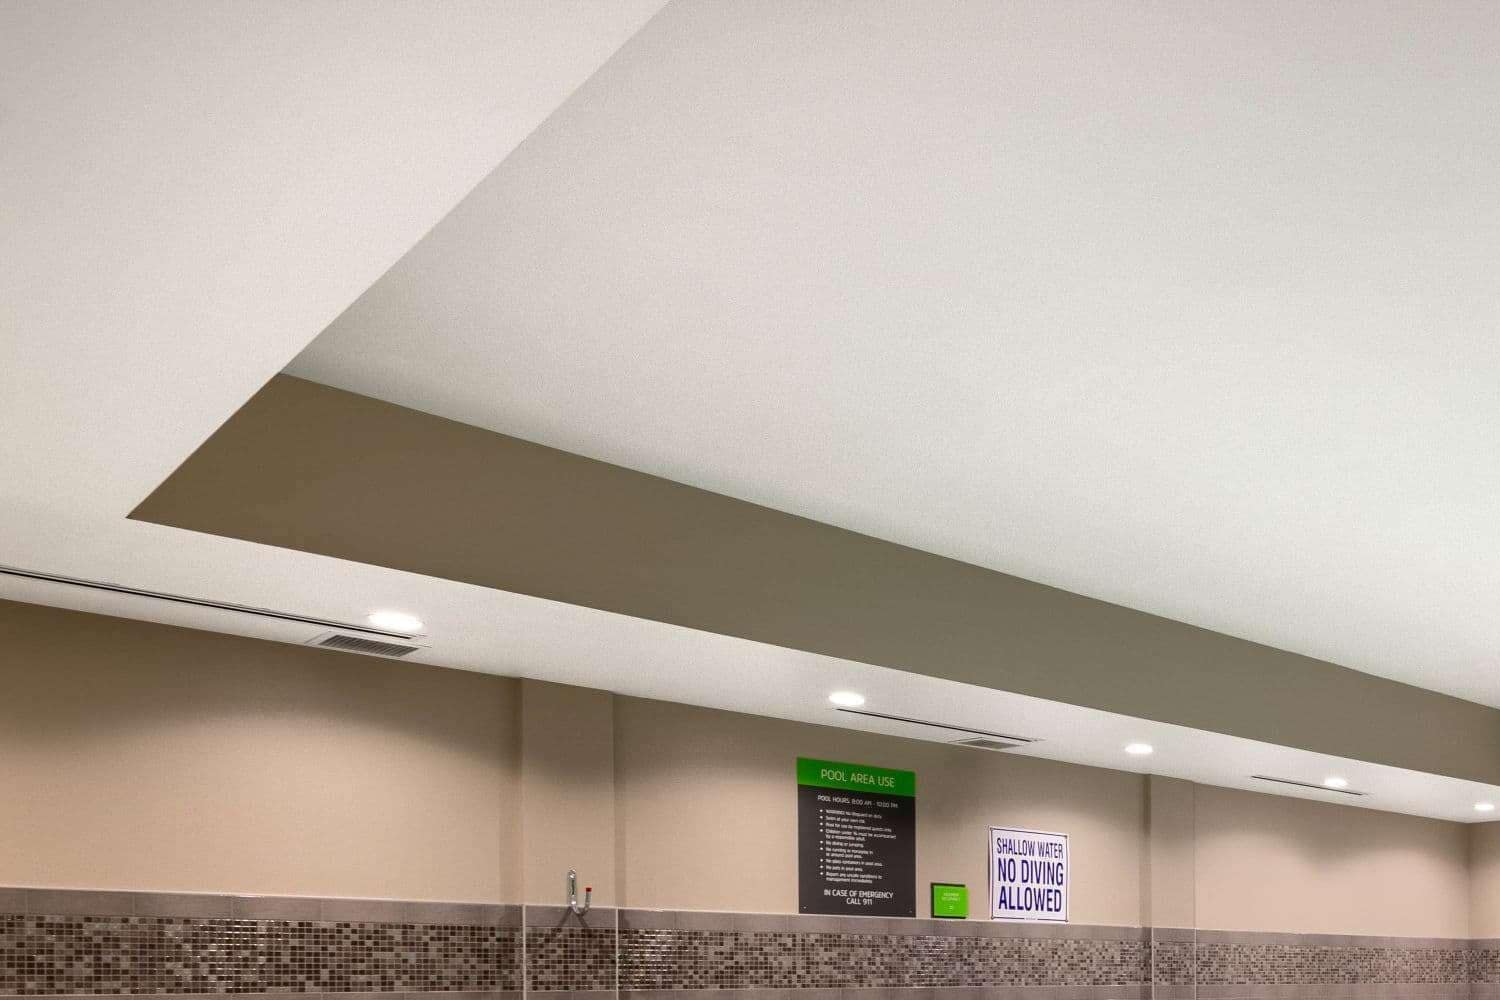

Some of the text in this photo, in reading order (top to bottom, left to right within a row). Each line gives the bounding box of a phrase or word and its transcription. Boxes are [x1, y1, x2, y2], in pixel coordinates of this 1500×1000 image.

[821, 768, 895, 788] POOL AREA USE
[996, 837, 1064, 859] SHALLOW WATER
[998, 858, 1064, 886] NO DIVING
[823, 888, 831, 896] IN
[832, 889, 848, 897] CASE
[859, 890, 894, 898] EMERGENCY
[998, 886, 1062, 912] ALLOWED
